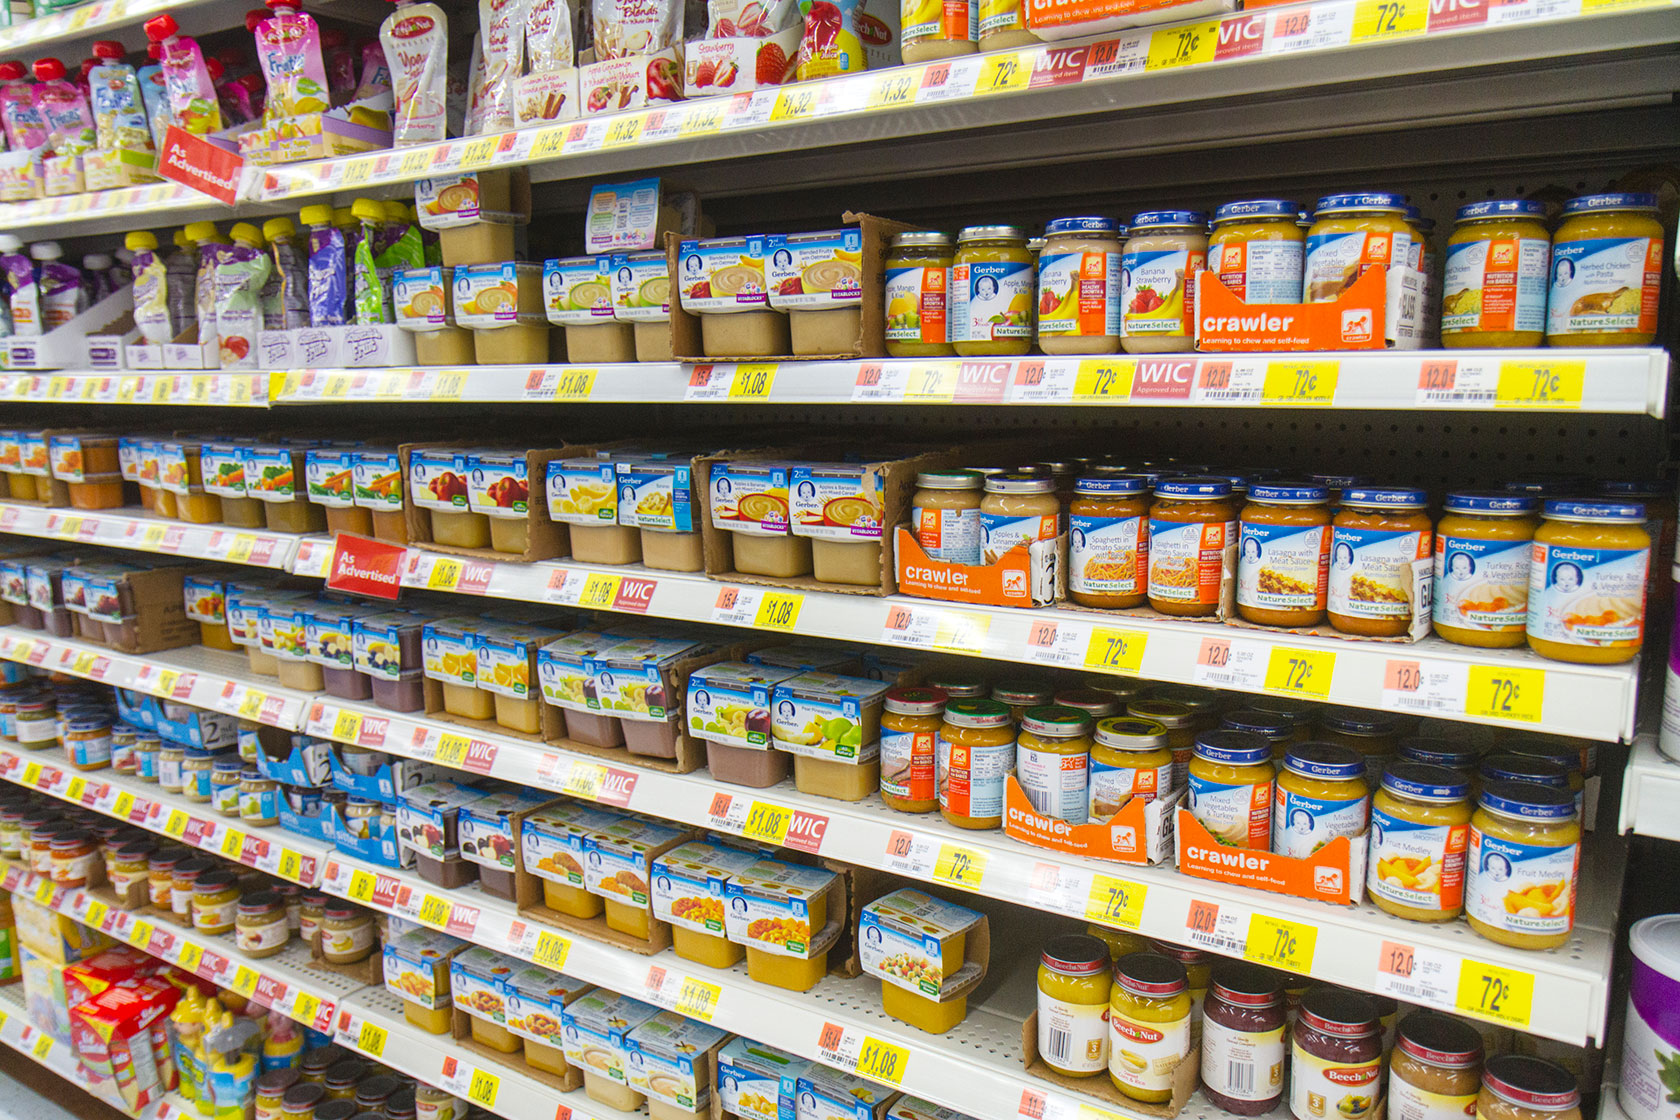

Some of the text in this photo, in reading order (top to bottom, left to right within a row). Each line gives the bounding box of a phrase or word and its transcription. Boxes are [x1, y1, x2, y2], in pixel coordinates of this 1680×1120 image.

[623, 7, 658, 19] Blends
[1034, 14, 1061, 25] Learning
[1376, 1, 1406, 33] 72¢
[1221, 20, 1266, 45] WIC
[698, 41, 734, 55] Strawberry
[1177, 31, 1199, 59] 72¢
[1036, 48, 1084, 71] WIC
[992, 61, 1018, 87] 72¢
[881, 80, 909, 102] $1.32
[783, 92, 810, 114] $1.32
[170, 143, 188, 156] As
[167, 155, 234, 191] Advertised
[1361, 195, 1392, 206] Gerber
[1587, 197, 1623, 208] Gerber
[1230, 203, 1260, 214] Gerber
[1082, 219, 1109, 230] Gerber
[1554, 246, 1586, 257] Gerber
[974, 266, 1006, 275] Gerber
[1140, 267, 1166, 276] Banana
[1580, 261, 1632, 271] Herbed Chicken
[1135, 275, 1172, 286] Strawberry
[1596, 271, 1614, 279] Pasta
[1202, 312, 1295, 333] crawler
[1202, 336, 1231, 346] Learning
[1278, 336, 1310, 344] self-feed
[961, 364, 1006, 384] WIC
[1139, 363, 1192, 383] WIC
[561, 370, 590, 396] $1.08
[738, 370, 767, 397] $1.08
[1093, 367, 1119, 395] 72¢
[1293, 368, 1318, 396] 72¢
[1532, 369, 1561, 398] 72¢
[1136, 386, 1187, 396] Approved item
[618, 477, 643, 487] Gerber
[1086, 481, 1112, 490] Gerber
[1163, 484, 1189, 494] Gerber
[1254, 488, 1280, 499] Gerber
[1375, 493, 1407, 503] Gerber
[1488, 500, 1521, 510] Gerber
[1572, 505, 1611, 516] Gerber
[993, 530, 1014, 540] Apples
[1242, 525, 1270, 538] Gerber
[1334, 531, 1363, 543] Gerber
[1091, 534, 1121, 545] Spaghetti
[1447, 539, 1486, 553] Gerber
[1088, 543, 1133, 553] Tomato Sauce
[1267, 547, 1314, 559] Lasagna with
[1551, 548, 1595, 562] Gerber
[339, 552, 356, 566] As
[1094, 551, 1109, 560] with
[1269, 557, 1312, 567] Meat Sauce
[1360, 554, 1409, 566] Lasagna with
[1362, 563, 1382, 573] Meat
[1486, 561, 1509, 572] Turkey,
[337, 564, 397, 585] Advertised
[463, 566, 493, 583] WIC
[904, 565, 969, 585] crawler
[1595, 572, 1623, 584] Turkey,
[588, 580, 612, 605] $1.08
[621, 581, 654, 601] WIC
[1083, 580, 1135, 592] NatureSelect
[1256, 594, 1314, 605] NatureSelect
[766, 598, 793, 626] $1.08
[1105, 637, 1128, 666] 72¢
[1288, 658, 1313, 690] 72¢
[1490, 678, 1520, 711] 72¢
[364, 718, 388, 735] WIC
[471, 743, 497, 761] WIC
[1206, 748, 1232, 761] Gerber
[1311, 765, 1342, 777] Gerber
[604, 774, 634, 795] WIC
[1098, 774, 1115, 785] Mixed
[1395, 781, 1424, 794] Gerber
[1209, 795, 1231, 806] Mixed
[1289, 796, 1324, 812] Gerber
[1203, 801, 1239, 815] Vegetables
[1519, 806, 1554, 817] Gerber
[750, 810, 780, 834] $1.08
[1008, 807, 1072, 838] crawler
[1212, 812, 1236, 823] Turkey
[1332, 812, 1355, 823] Mixed
[790, 813, 824, 838] WIC
[1324, 820, 1360, 832] Vegetables
[1385, 839, 1432, 858] Fruit Medley
[1483, 838, 1523, 856] Gerber
[949, 852, 972, 880] 72¢
[1187, 845, 1270, 873] crawler
[1187, 863, 1215, 875] Learning
[1224, 870, 1241, 880] chew
[1256, 875, 1286, 890] self-feed
[1516, 867, 1567, 880] Fruit Medley
[374, 877, 399, 897] WIC
[1106, 887, 1129, 918] 72¢
[452, 906, 478, 927] WIC
[538, 937, 563, 961] $1.08
[1273, 928, 1297, 959] 72¢
[683, 983, 711, 1009] $1.08
[1481, 975, 1511, 1012] 72¢
[862, 1048, 898, 1077] $1.08
[720, 1065, 746, 1080] Gerber
